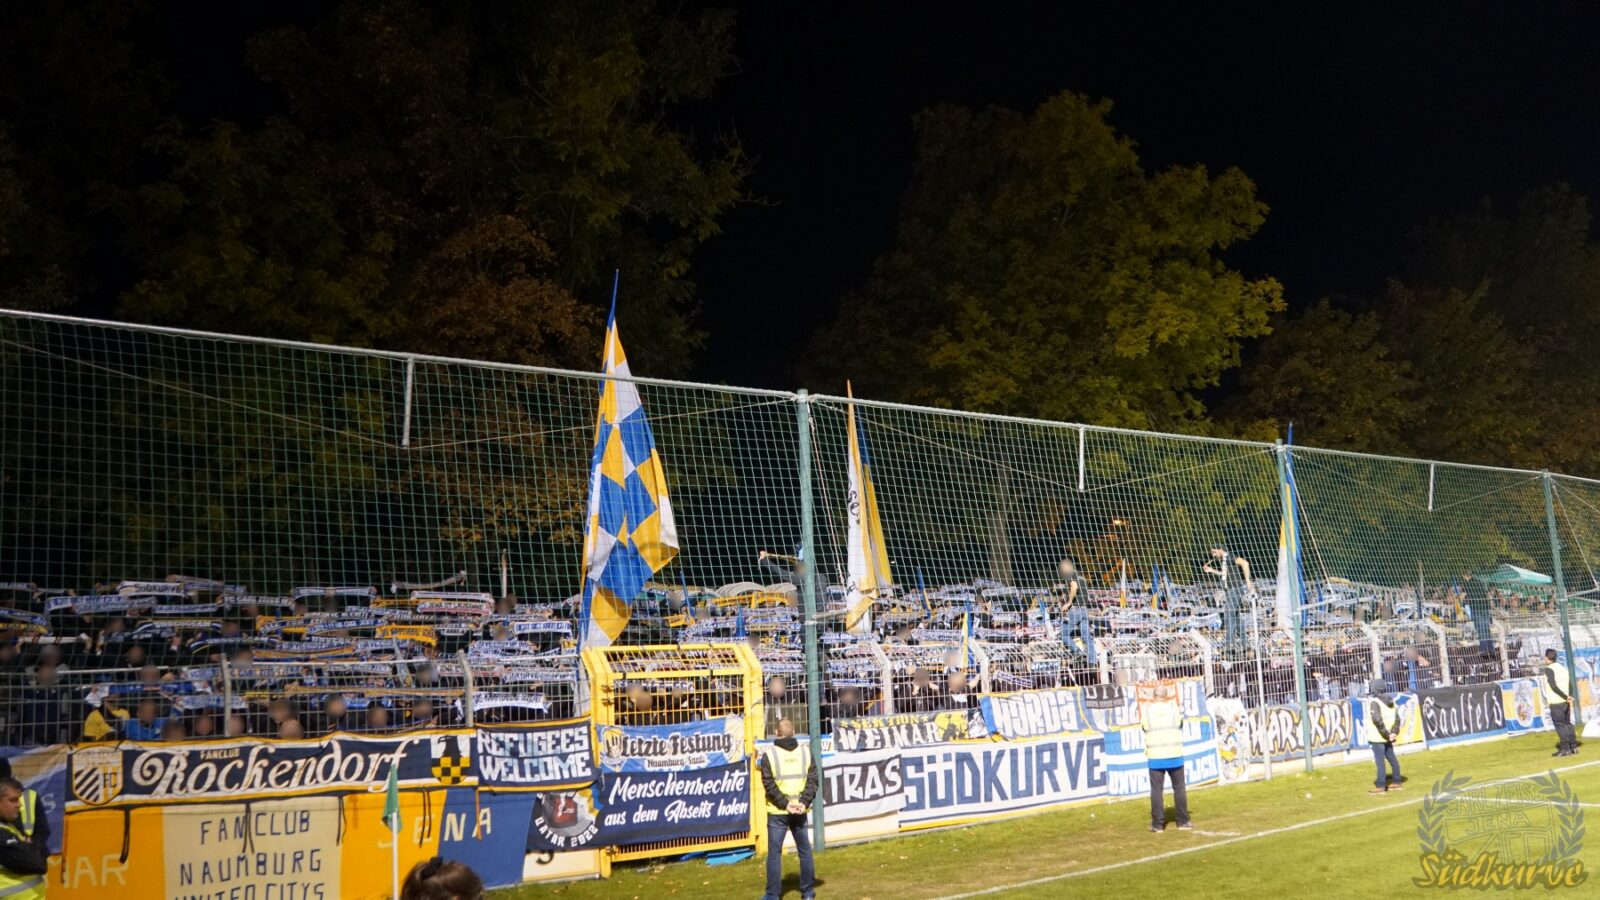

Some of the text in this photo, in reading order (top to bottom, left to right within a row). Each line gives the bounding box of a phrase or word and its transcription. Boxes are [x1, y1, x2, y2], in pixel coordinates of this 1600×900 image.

[1422, 691, 1502, 738] Saalfeld
[477, 726, 589, 757] REFUGEES
[621, 734, 731, 757] Letzte Festung
[837, 720, 943, 751] WEIMAR
[132, 739, 420, 797] Rockendorf
[200, 749, 240, 760] FANCLUB
[479, 751, 592, 782] WELCOME
[103, 772, 117, 788] FC
[608, 769, 749, 805] Menschenrechte
[823, 758, 902, 805] TRAS
[902, 738, 1107, 812] SÜDKURVE
[200, 810, 310, 845] FANCLUB
[604, 797, 748, 827] aus dem Abseits holen
[534, 816, 599, 848] QATAR 2022
[180, 849, 321, 886] NAUMBURG
